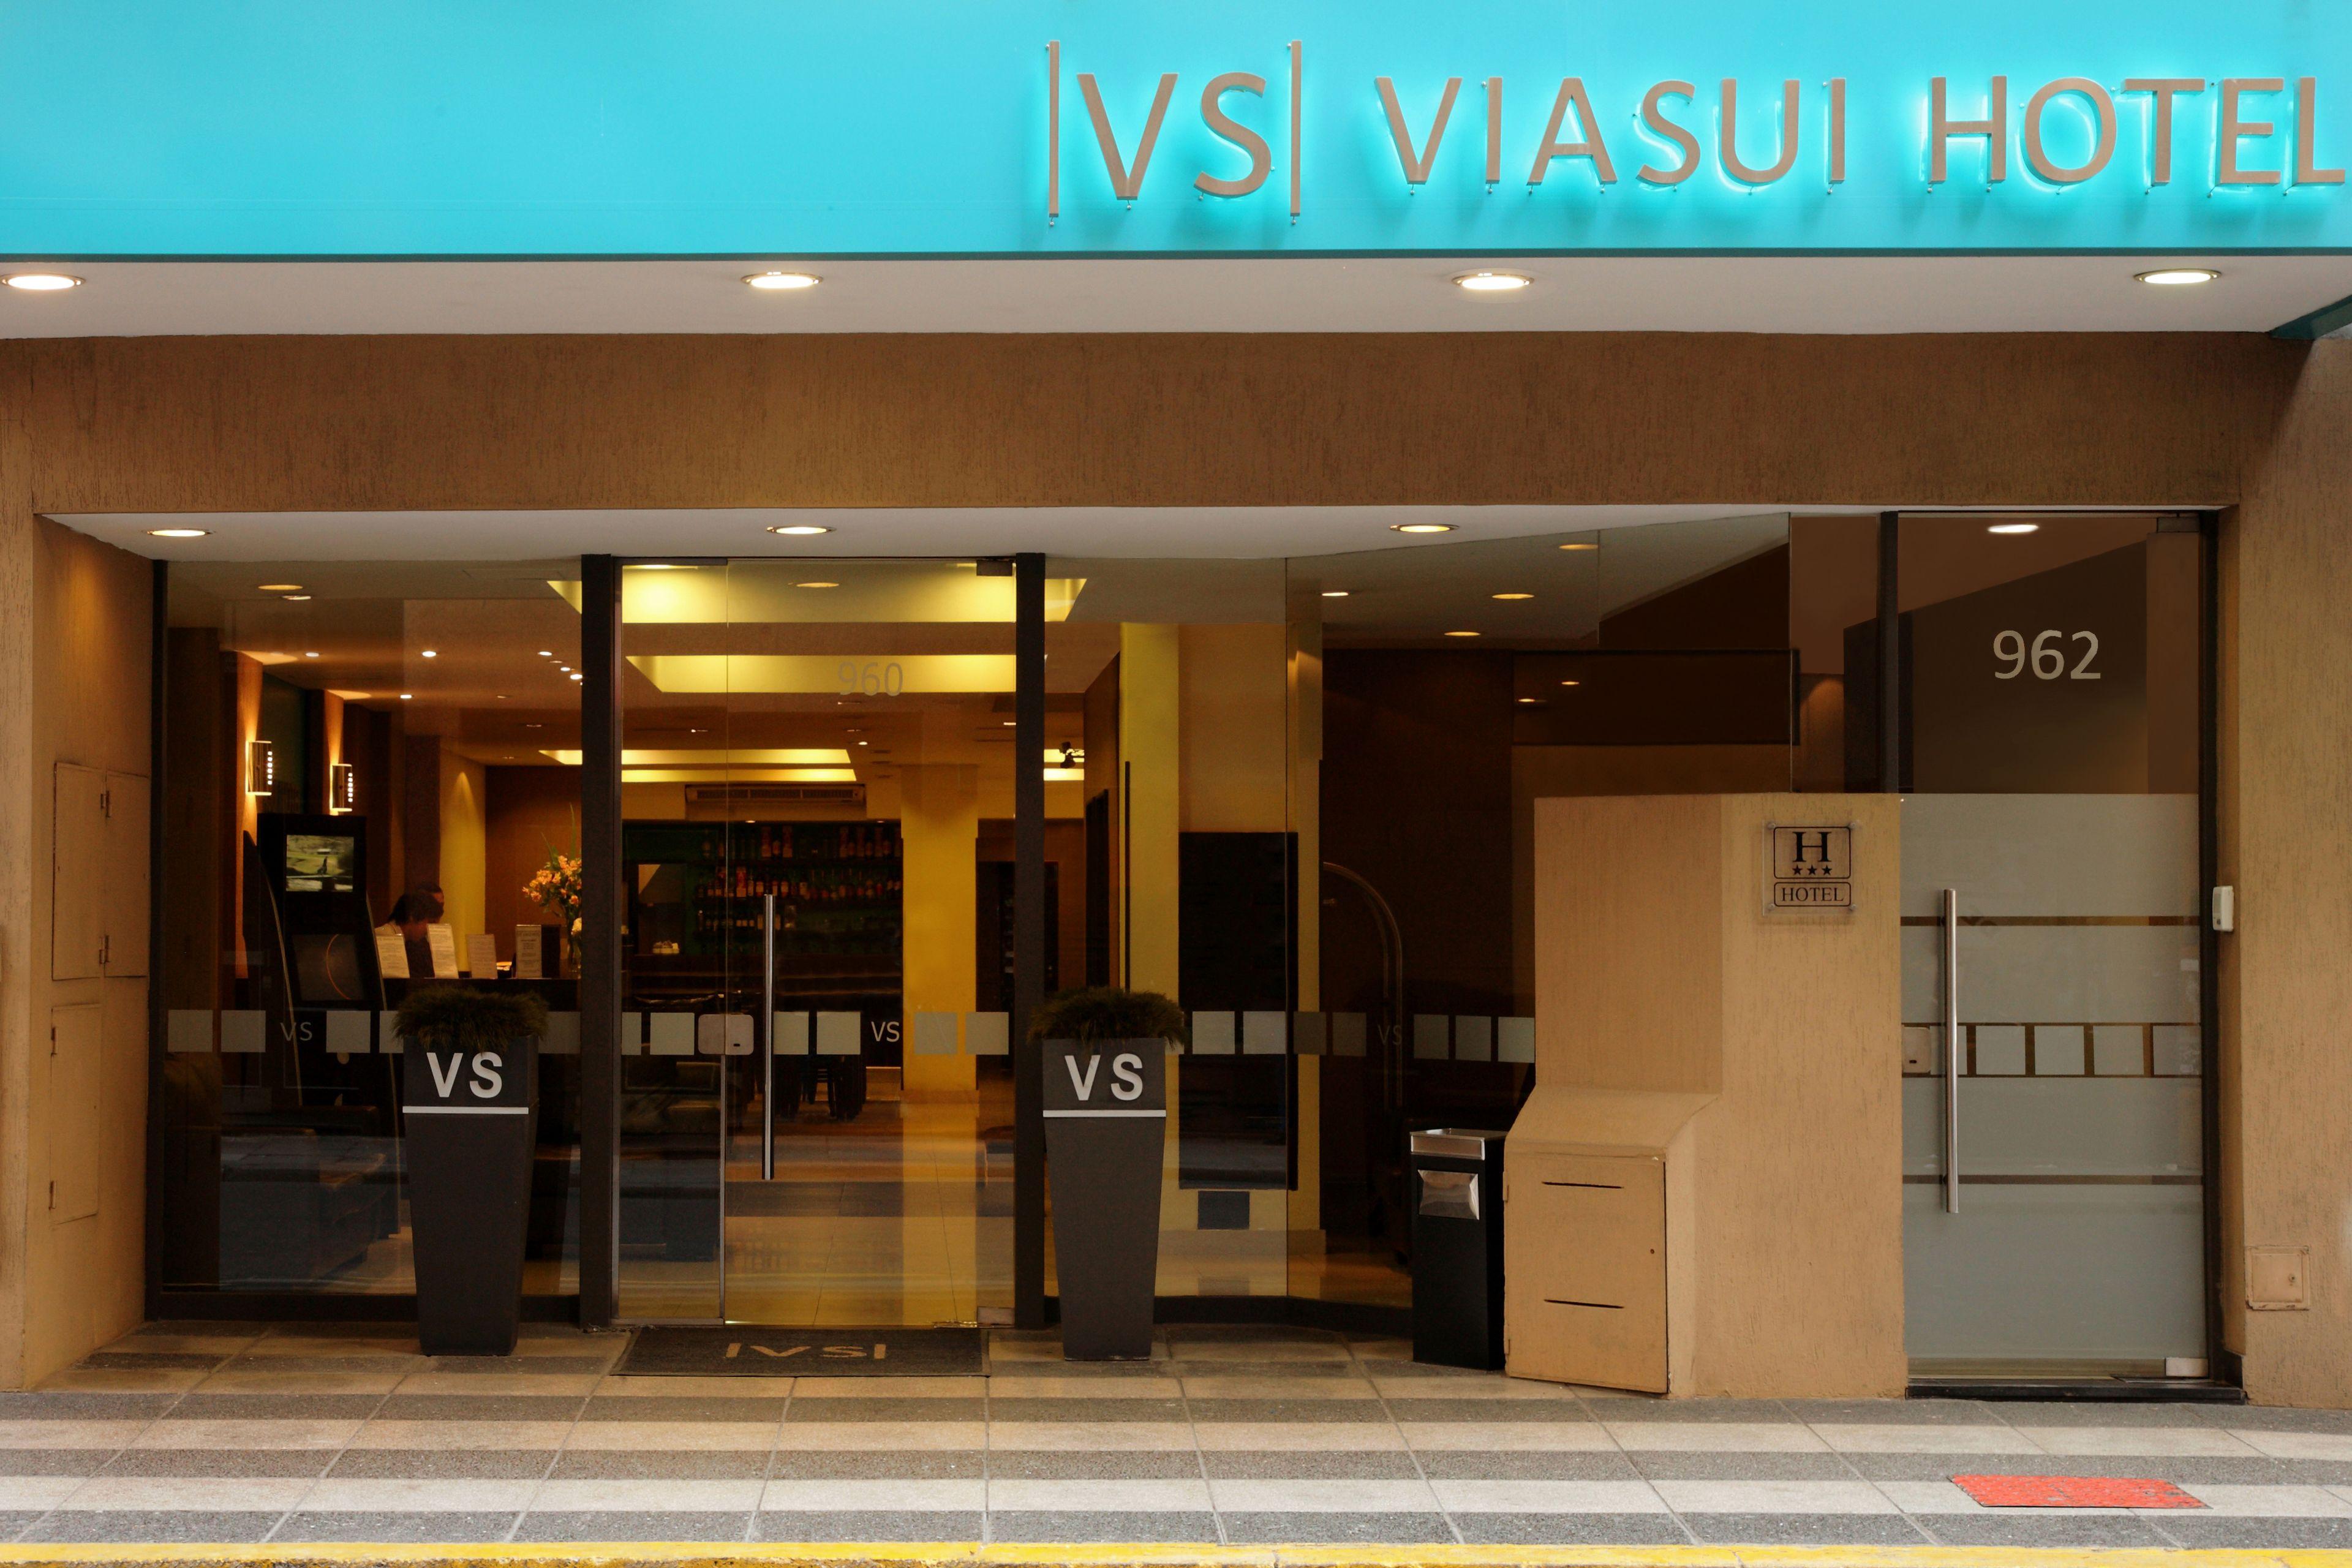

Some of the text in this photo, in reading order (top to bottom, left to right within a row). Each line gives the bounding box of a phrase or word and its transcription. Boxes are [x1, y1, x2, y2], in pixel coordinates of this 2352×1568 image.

[1374, 76, 1846, 186] VIASUI
[1928, 75, 2346, 186] HOTEL
[1992, 629, 2101, 680] 962
[837, 661, 903, 696] 960
[1792, 831, 1832, 862] H
[1781, 887, 1844, 902] HOTEL
[280, 1021, 313, 1041] VS
[870, 1020, 900, 1042] VS
[1377, 1024, 1403, 1046] VS
[426, 1052, 503, 1099] VS
[1064, 1053, 1144, 1101] VS
